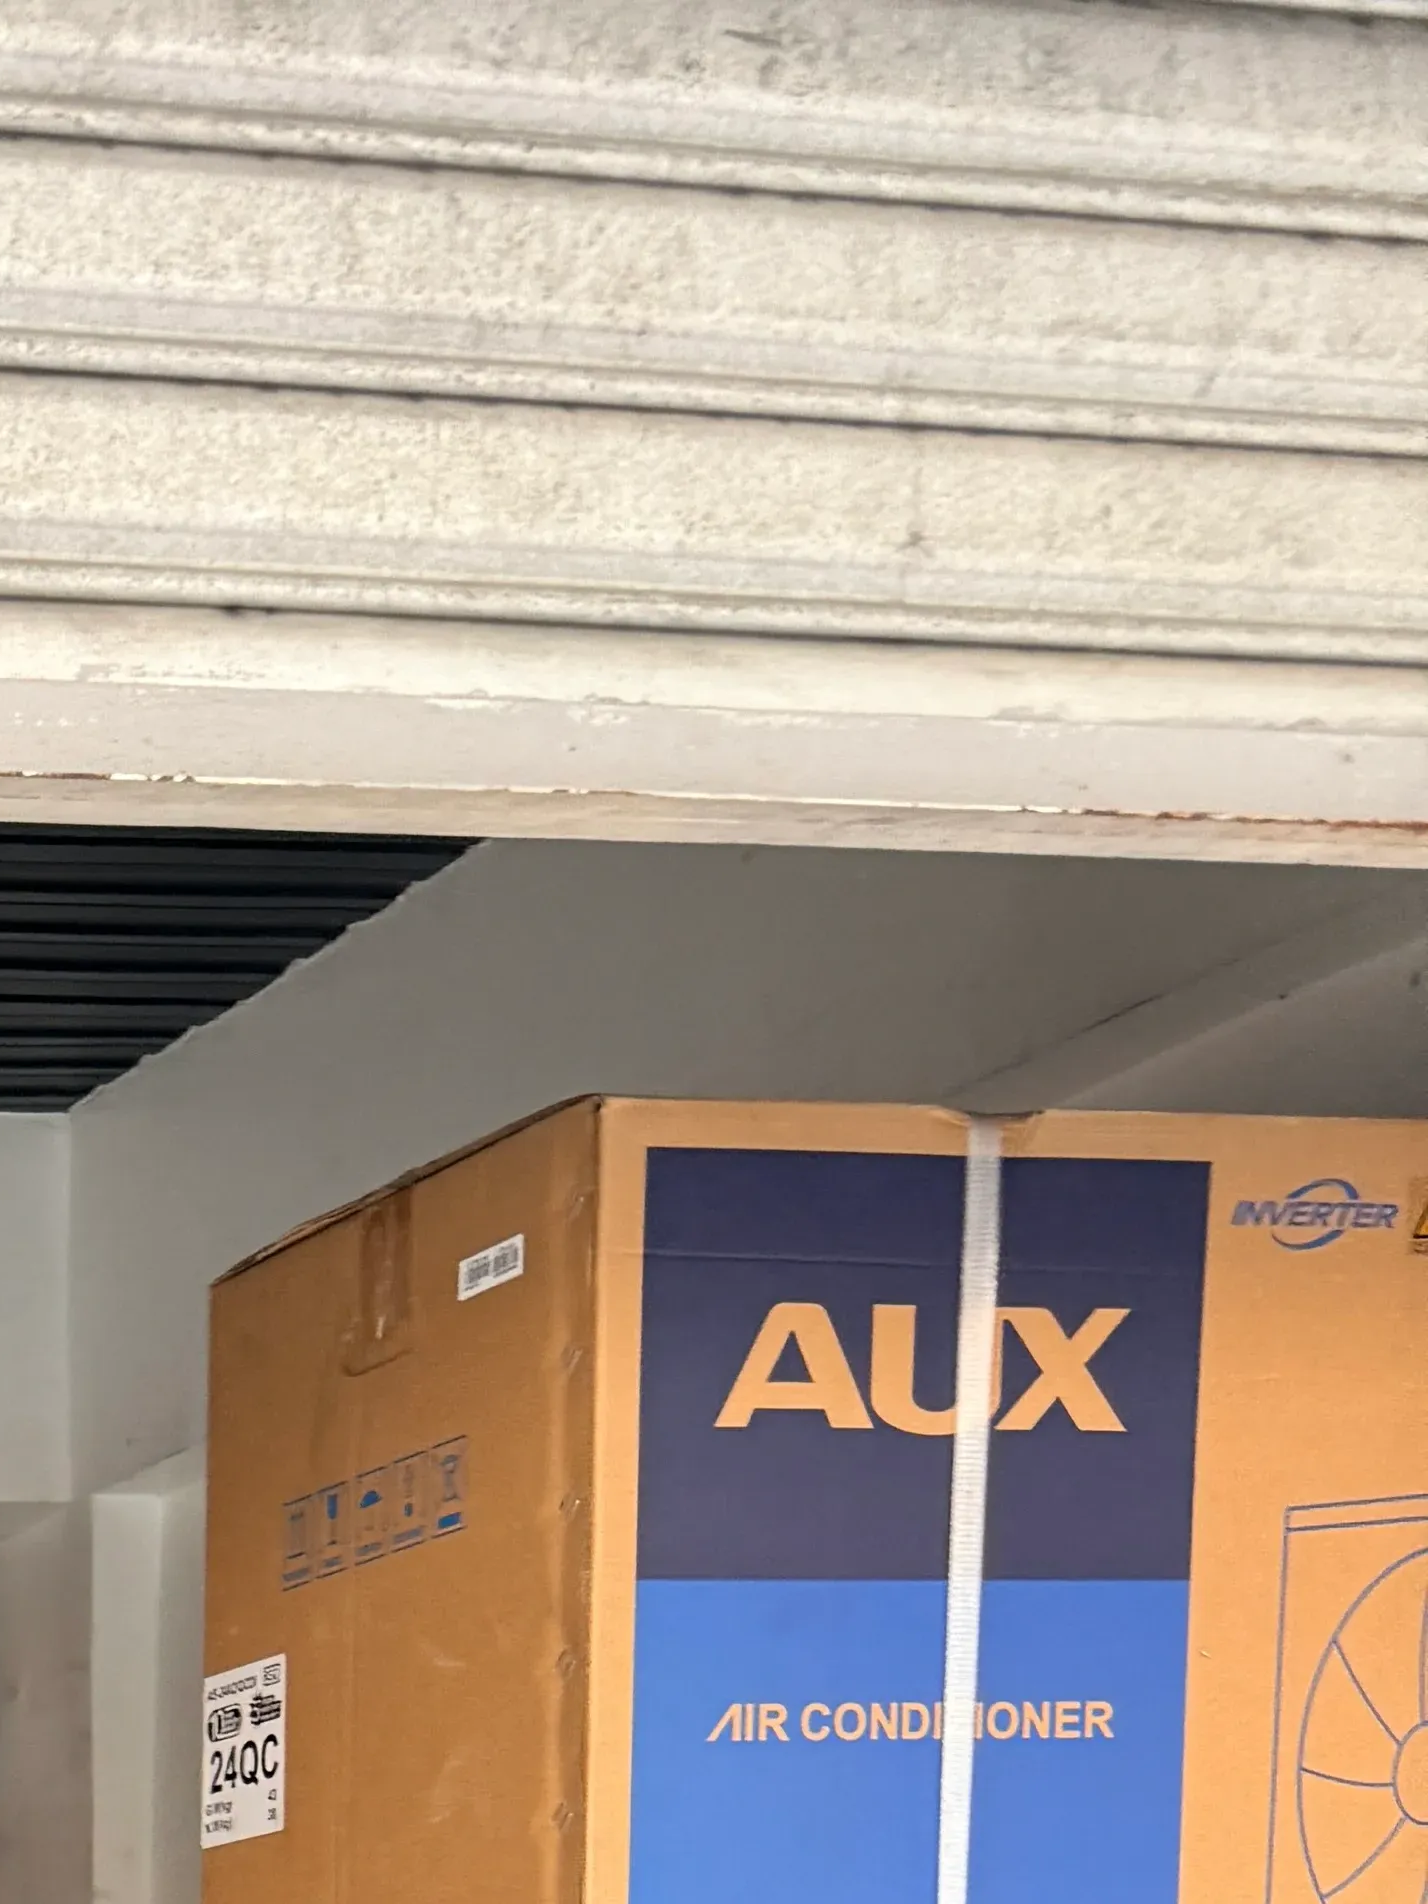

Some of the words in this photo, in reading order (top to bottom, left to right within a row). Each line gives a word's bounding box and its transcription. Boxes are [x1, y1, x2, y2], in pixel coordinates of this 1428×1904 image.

[1231, 1197, 1399, 1232] INVERTER
[714, 1302, 1131, 1435] AUX
[706, 1702, 790, 1741] AIR
[800, 1702, 1114, 1740] CONDIIONER
[210, 1733, 279, 1795] 24QC
